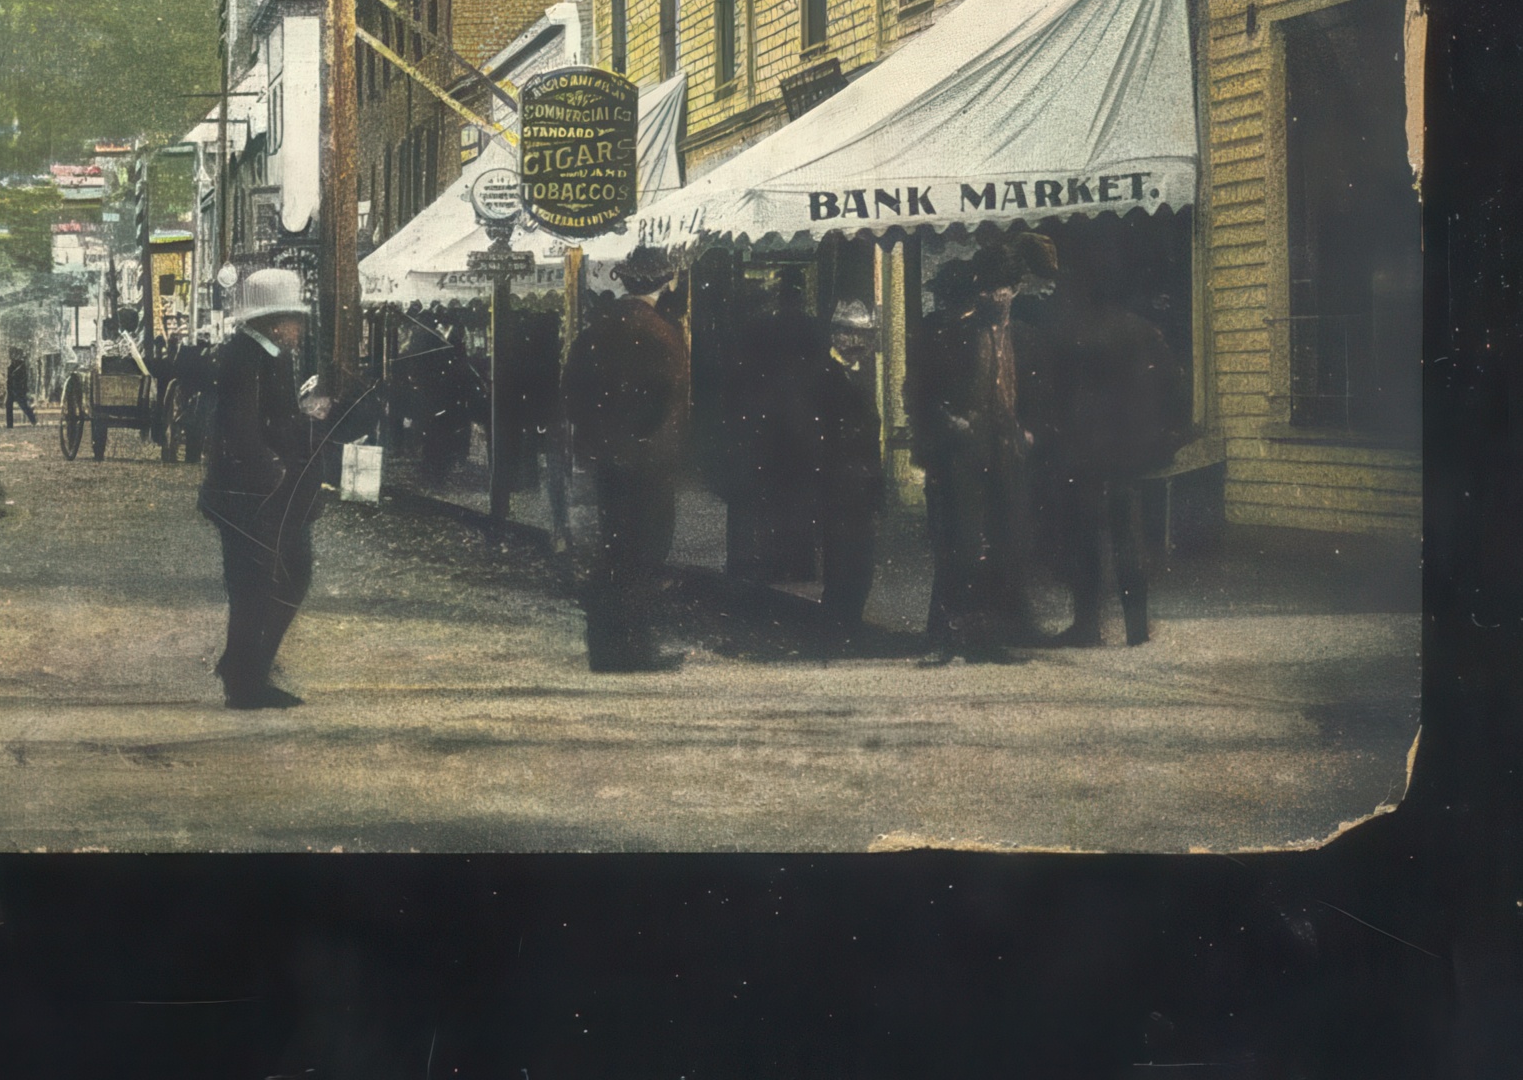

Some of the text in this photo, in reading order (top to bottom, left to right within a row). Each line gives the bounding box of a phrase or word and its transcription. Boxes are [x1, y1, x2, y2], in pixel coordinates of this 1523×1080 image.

[523, 125, 595, 139] STANDARD
[523, 138, 635, 176] CIGARS
[521, 182, 629, 202] TOBACCOS
[808, 171, 1161, 221] BANK MARKET.
